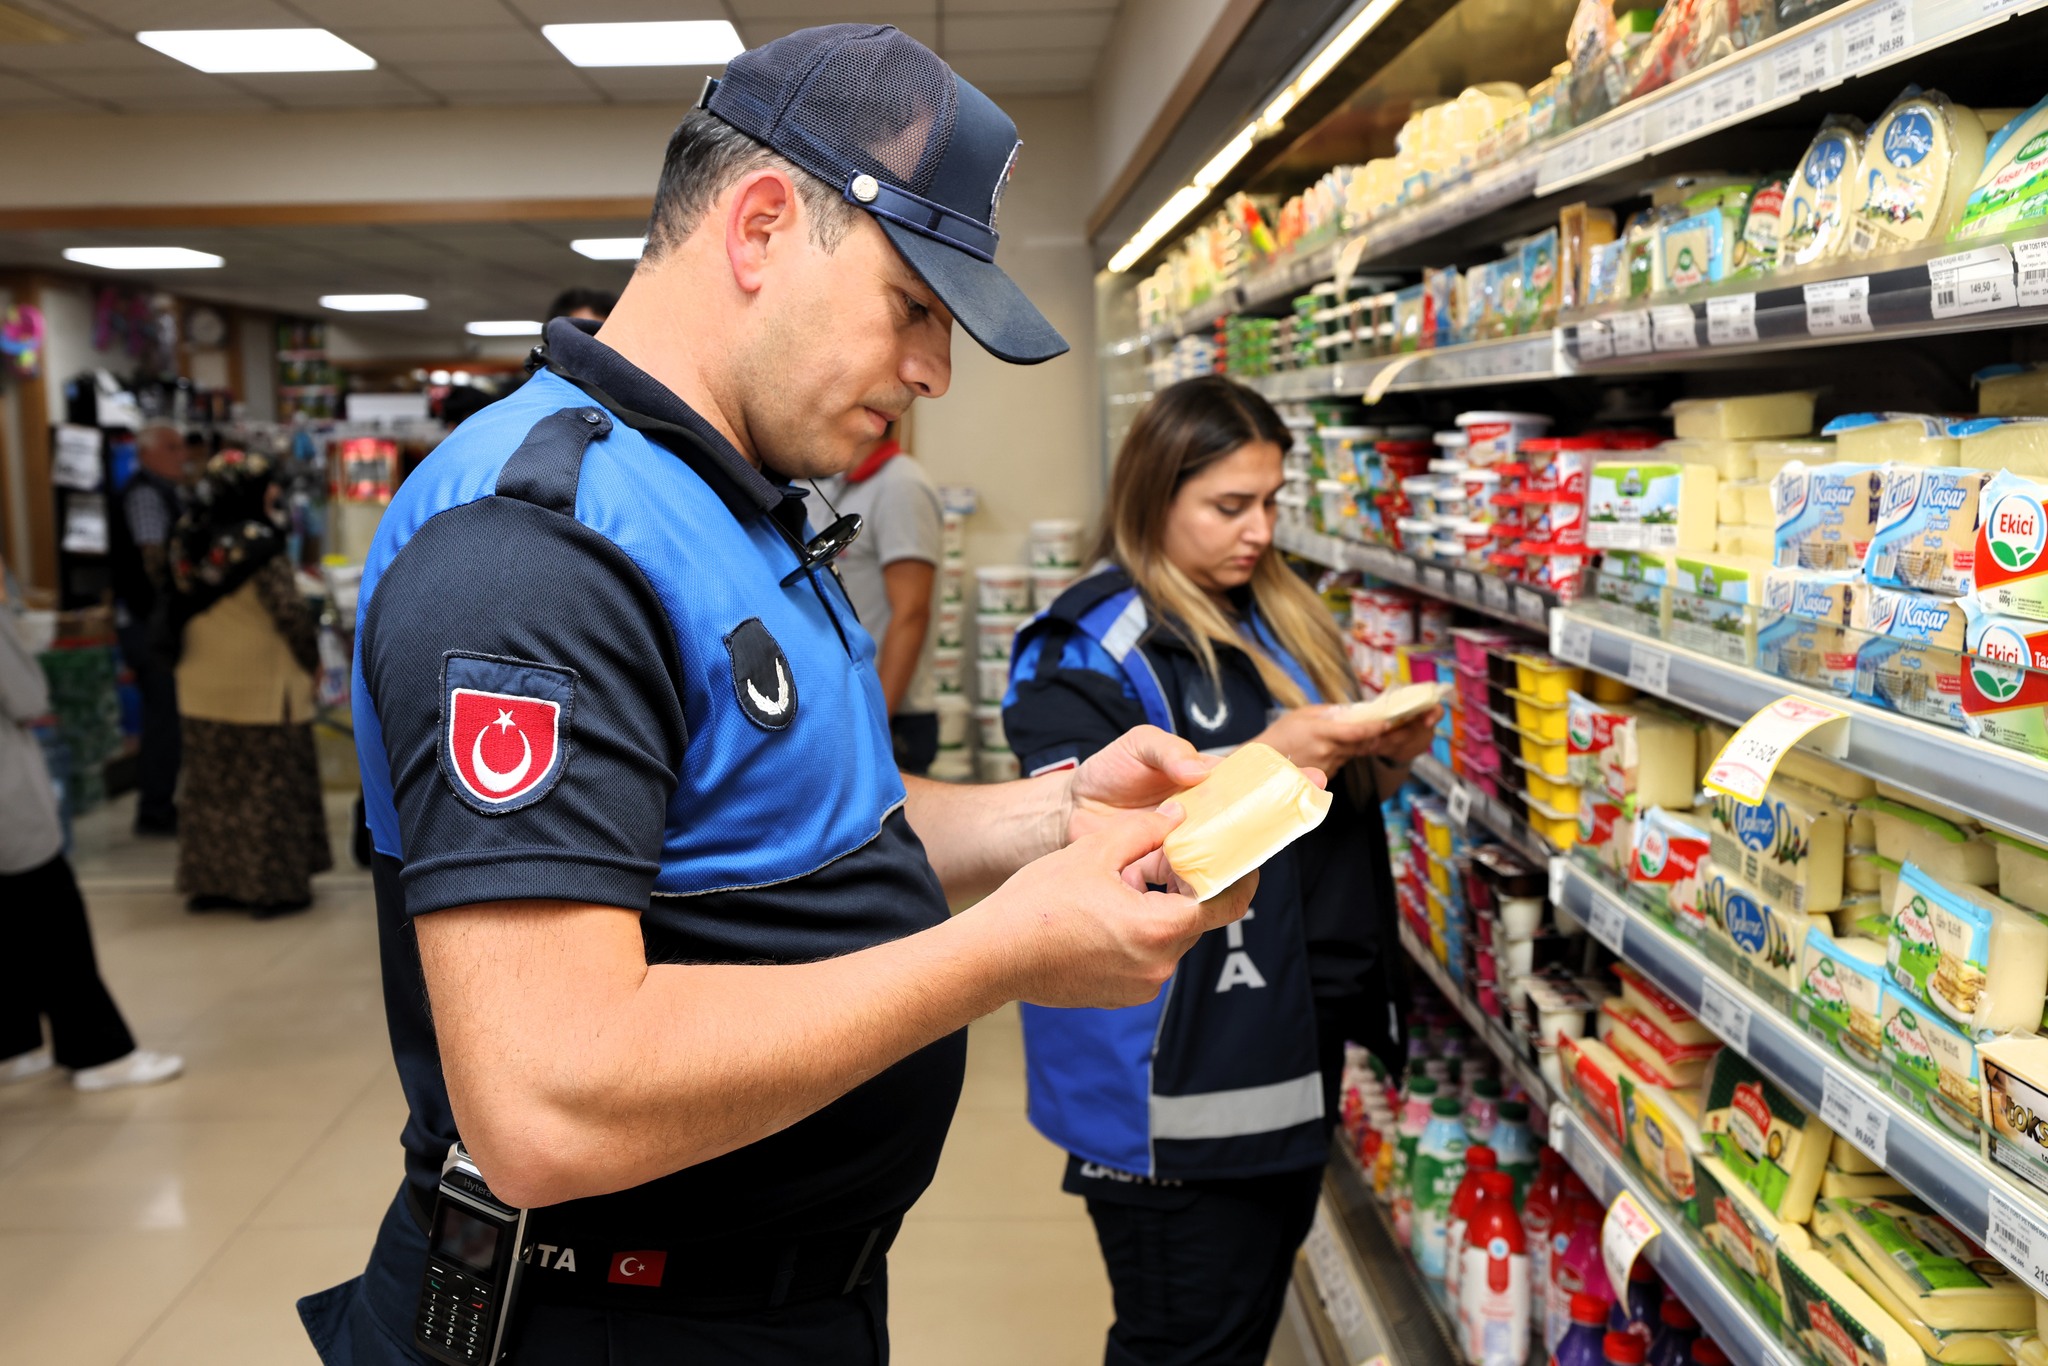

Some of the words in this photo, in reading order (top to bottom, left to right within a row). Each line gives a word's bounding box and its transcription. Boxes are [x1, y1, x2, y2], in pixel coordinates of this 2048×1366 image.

[1971, 281, 1990, 294] 149,50
[1814, 476, 1854, 508] Kaşar
[1922, 476, 1967, 513] Kaşar
[1999, 513, 2034, 536] Ekici
[1901, 598, 1949, 632] Kaşar
[464, 1178, 492, 1198] Hytera
